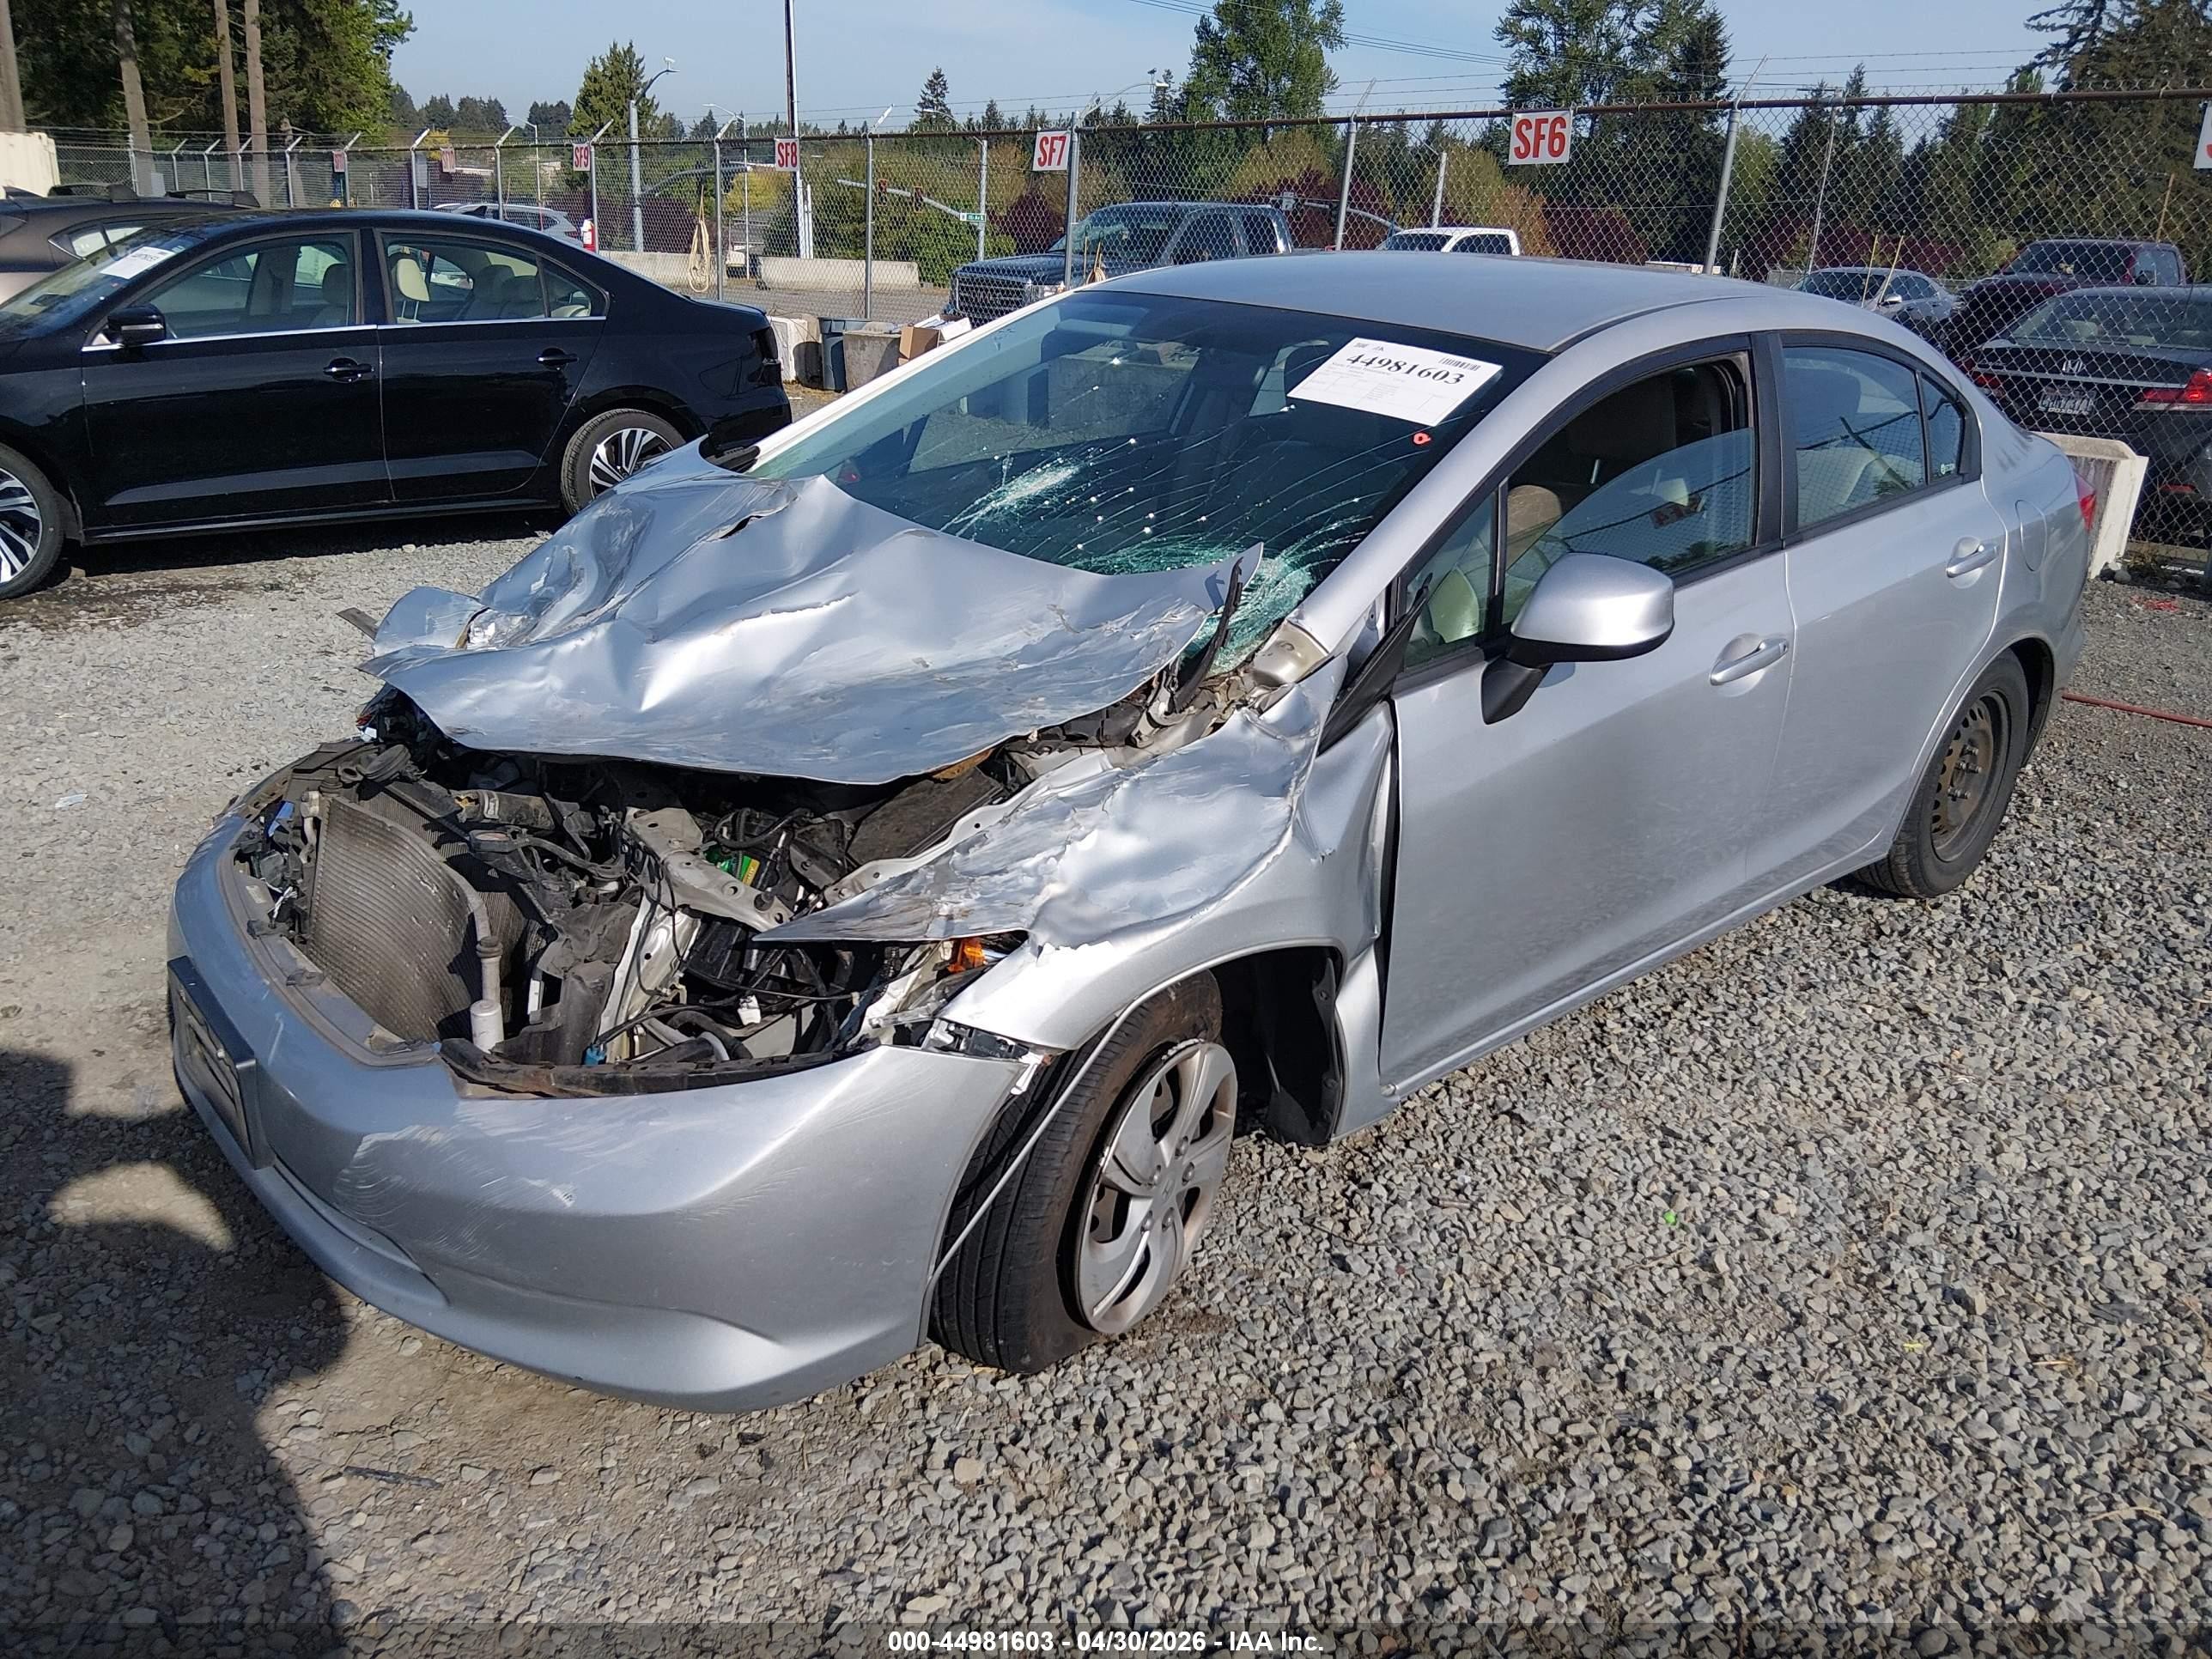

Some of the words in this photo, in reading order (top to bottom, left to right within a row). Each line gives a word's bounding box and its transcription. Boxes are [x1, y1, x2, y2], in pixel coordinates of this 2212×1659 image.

[1037, 136, 1067, 167] SF7
[1513, 116, 1567, 160] SF6
[574, 146, 589, 168] SF9
[777, 141, 798, 168] SF8
[1346, 353, 1465, 386] 44981603
